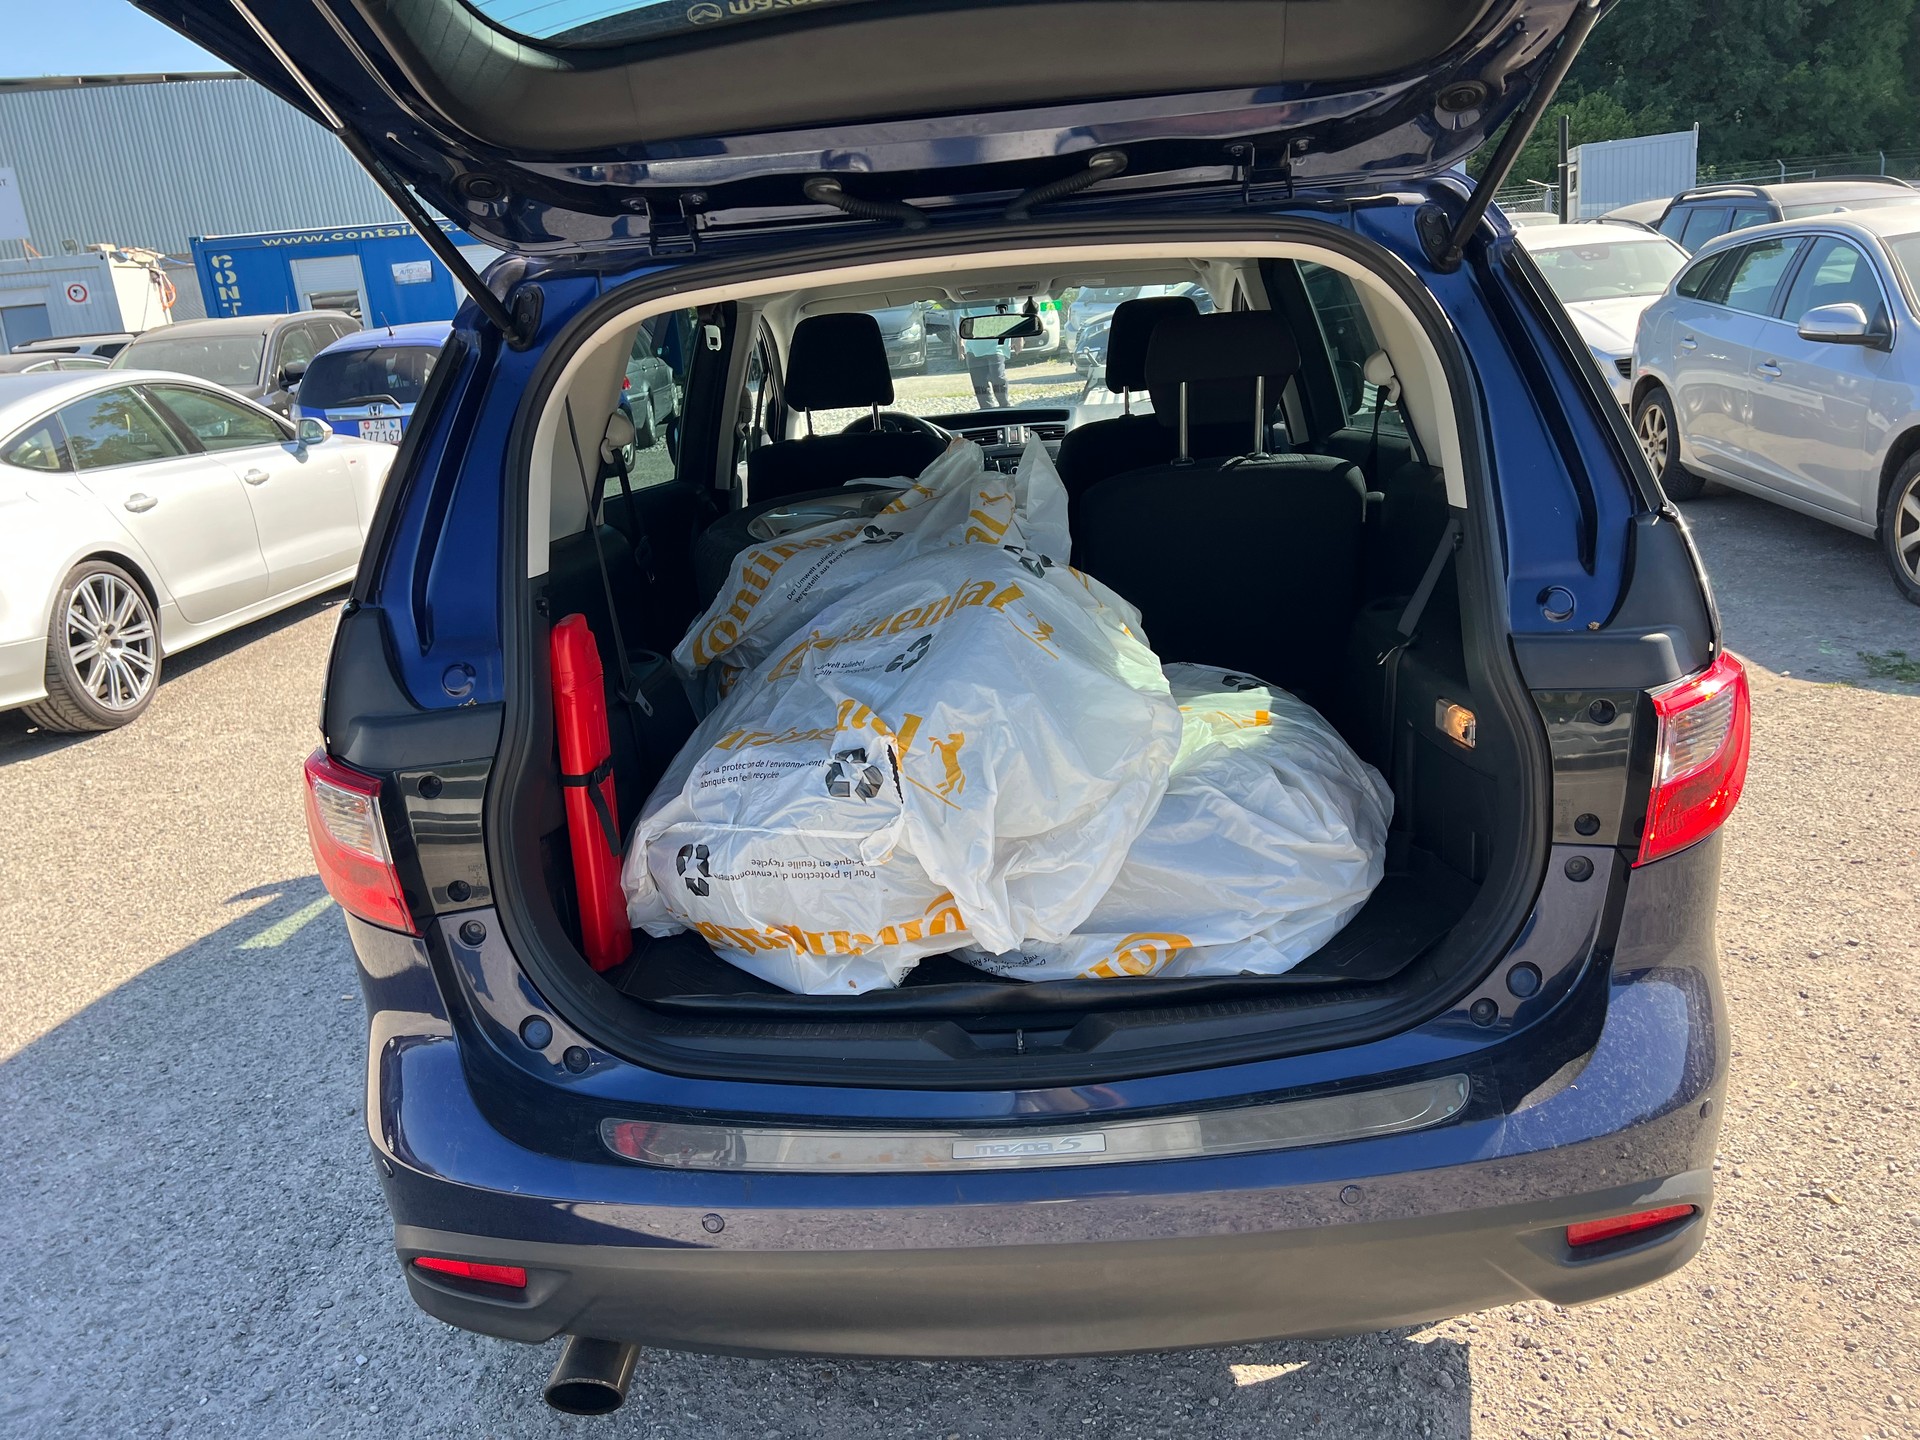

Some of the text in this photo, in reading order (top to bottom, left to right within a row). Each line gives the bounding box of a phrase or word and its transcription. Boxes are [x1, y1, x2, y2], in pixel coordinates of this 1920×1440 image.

[374, 420, 386, 430] ZH
[362, 429, 400, 442] 177 167
[819, 565, 830, 576] aus
[786, 588, 797, 601] Der
[795, 565, 817, 589] Umwelt
[755, 759, 765, 768] de
[728, 775, 738, 783] en
[787, 858, 817, 869] feuille
[820, 860, 831, 868] en
[791, 869, 841, 880] protection
[843, 870, 852, 879] la
[856, 870, 876, 879] Pour
